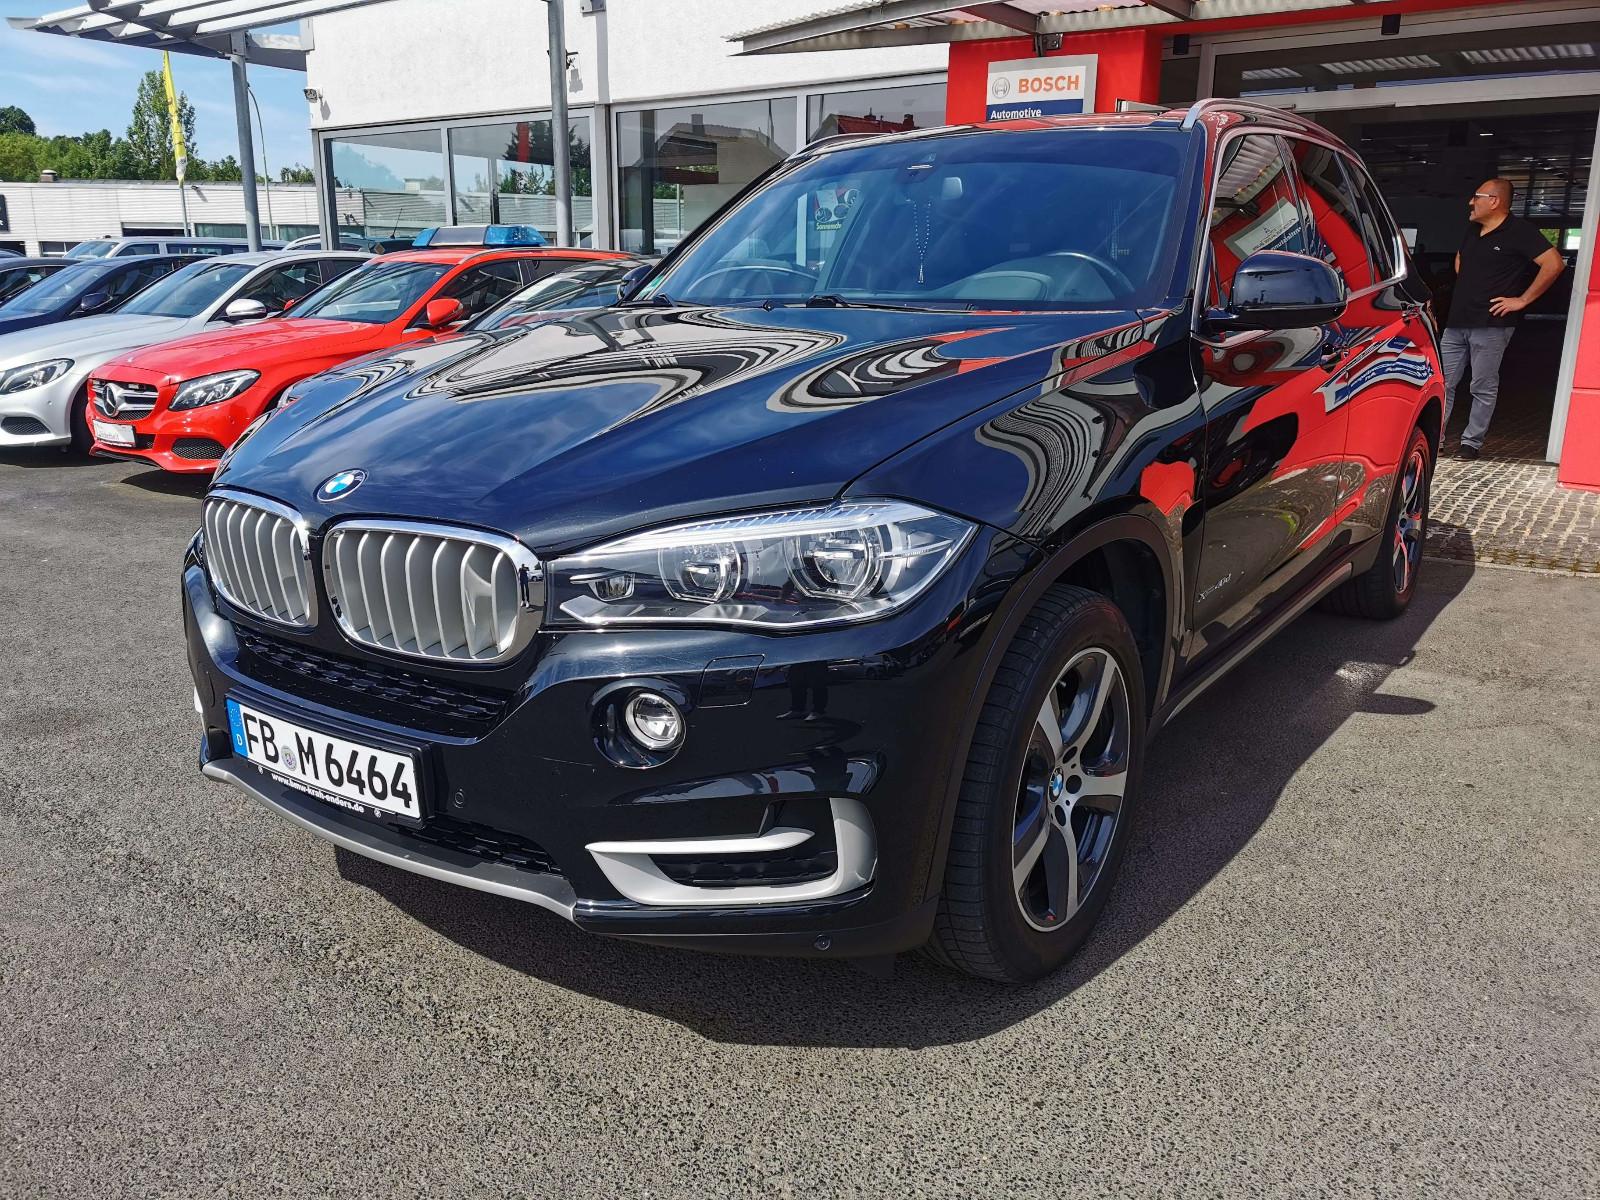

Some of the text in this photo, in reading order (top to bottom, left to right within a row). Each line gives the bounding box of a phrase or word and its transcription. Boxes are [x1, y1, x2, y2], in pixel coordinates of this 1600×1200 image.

[1018, 75, 1079, 93] BOSCH
[990, 108, 1042, 120] Automotive
[236, 733, 243, 746] D
[243, 712, 279, 763] FB
[271, 773, 364, 813] www.bmw-krah-enders.de
